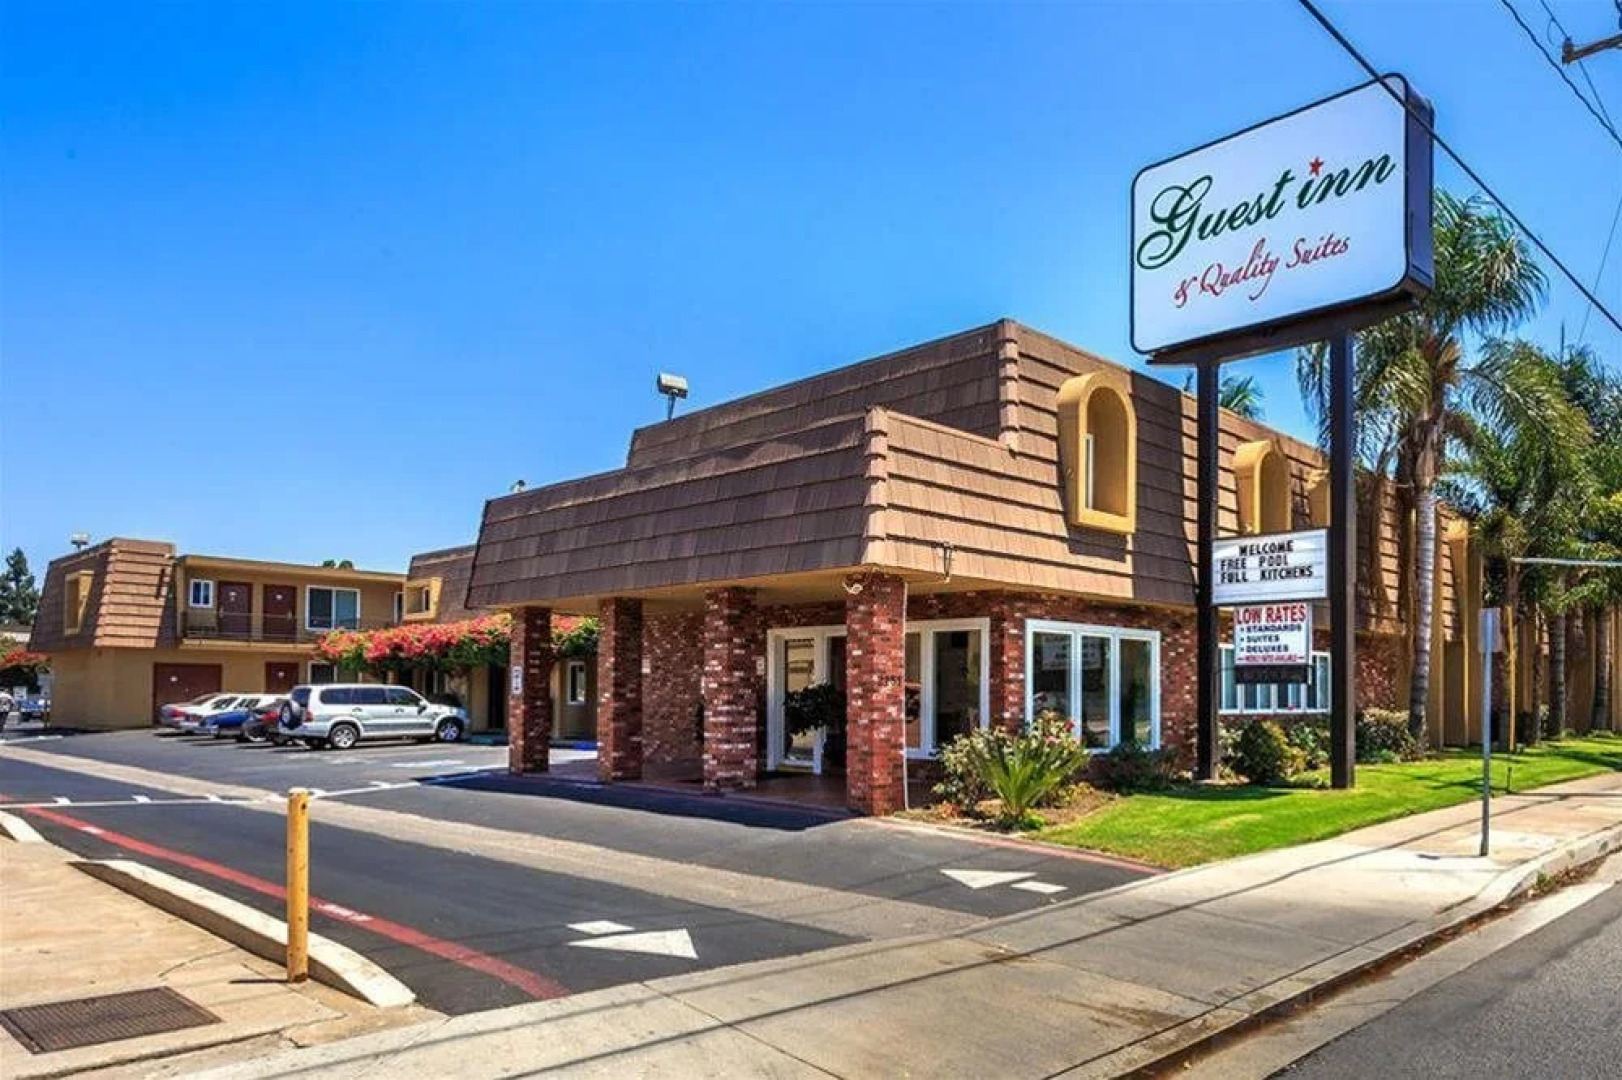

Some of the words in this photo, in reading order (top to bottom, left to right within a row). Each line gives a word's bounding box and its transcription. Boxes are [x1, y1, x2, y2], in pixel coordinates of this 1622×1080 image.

[1136, 169, 1294, 269] Guest
[1296, 153, 1396, 209] inn
[1174, 275, 1197, 308] &
[1198, 237, 1280, 301] Quality
[1285, 233, 1351, 268] Suites
[1240, 541, 1293, 556] WELCOME
[1220, 558, 1246, 571] FREE
[1259, 555, 1288, 567] POOL
[1220, 571, 1249, 584] FULL
[1261, 566, 1312, 581] KITCHENS
[1237, 608, 1261, 624] LOW
[1267, 605, 1305, 622] RATES
[1246, 634, 1280, 643] SUITES
